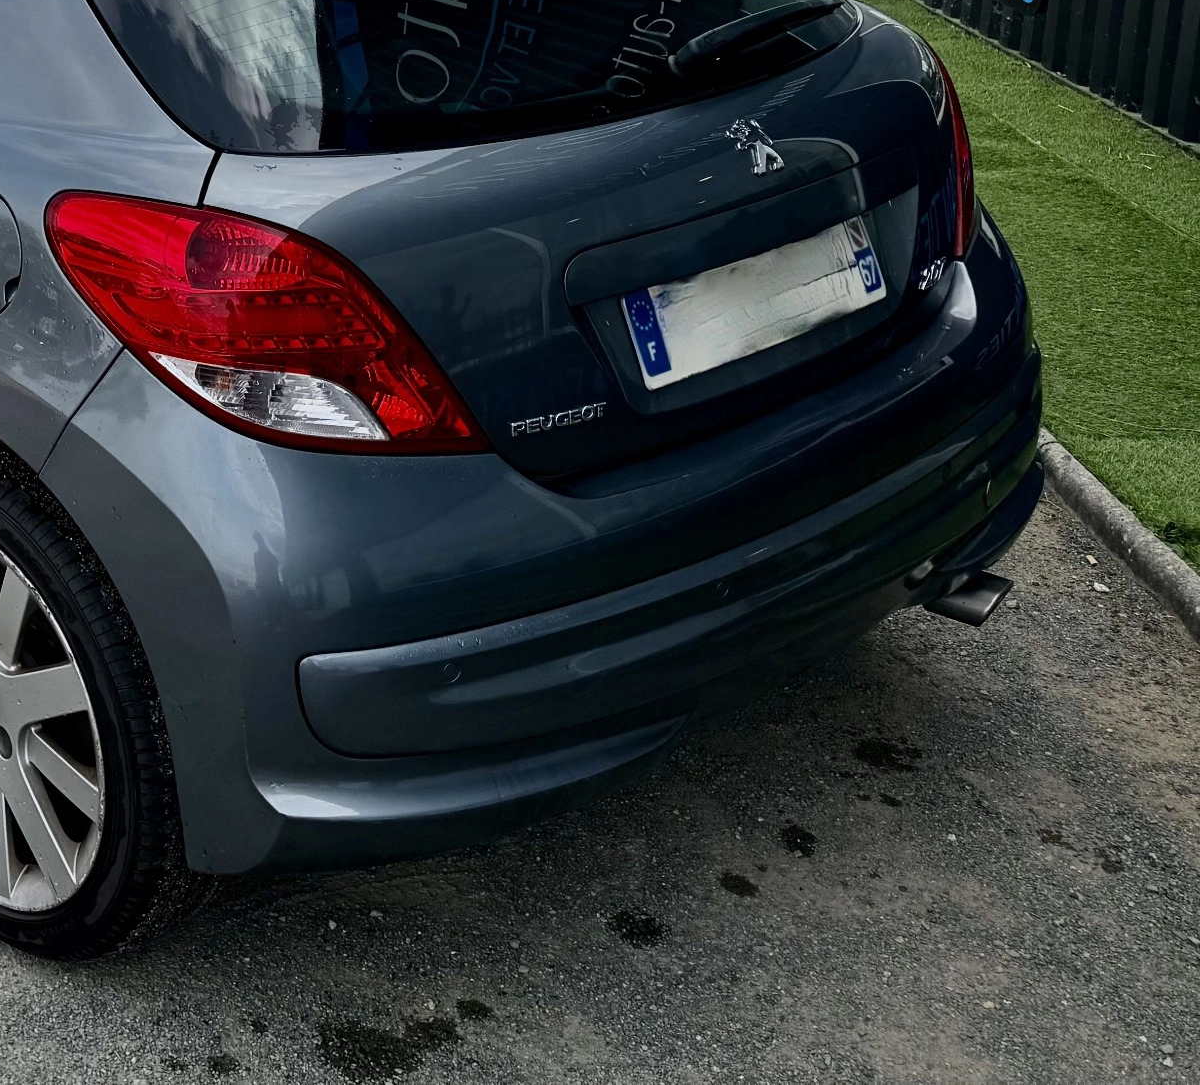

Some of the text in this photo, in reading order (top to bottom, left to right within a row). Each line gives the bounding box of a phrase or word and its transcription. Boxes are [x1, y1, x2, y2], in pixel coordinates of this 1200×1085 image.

[860, 260, 878, 287] 67
[646, 341, 659, 362] F
[511, 401, 607, 437] PEUGEOT
